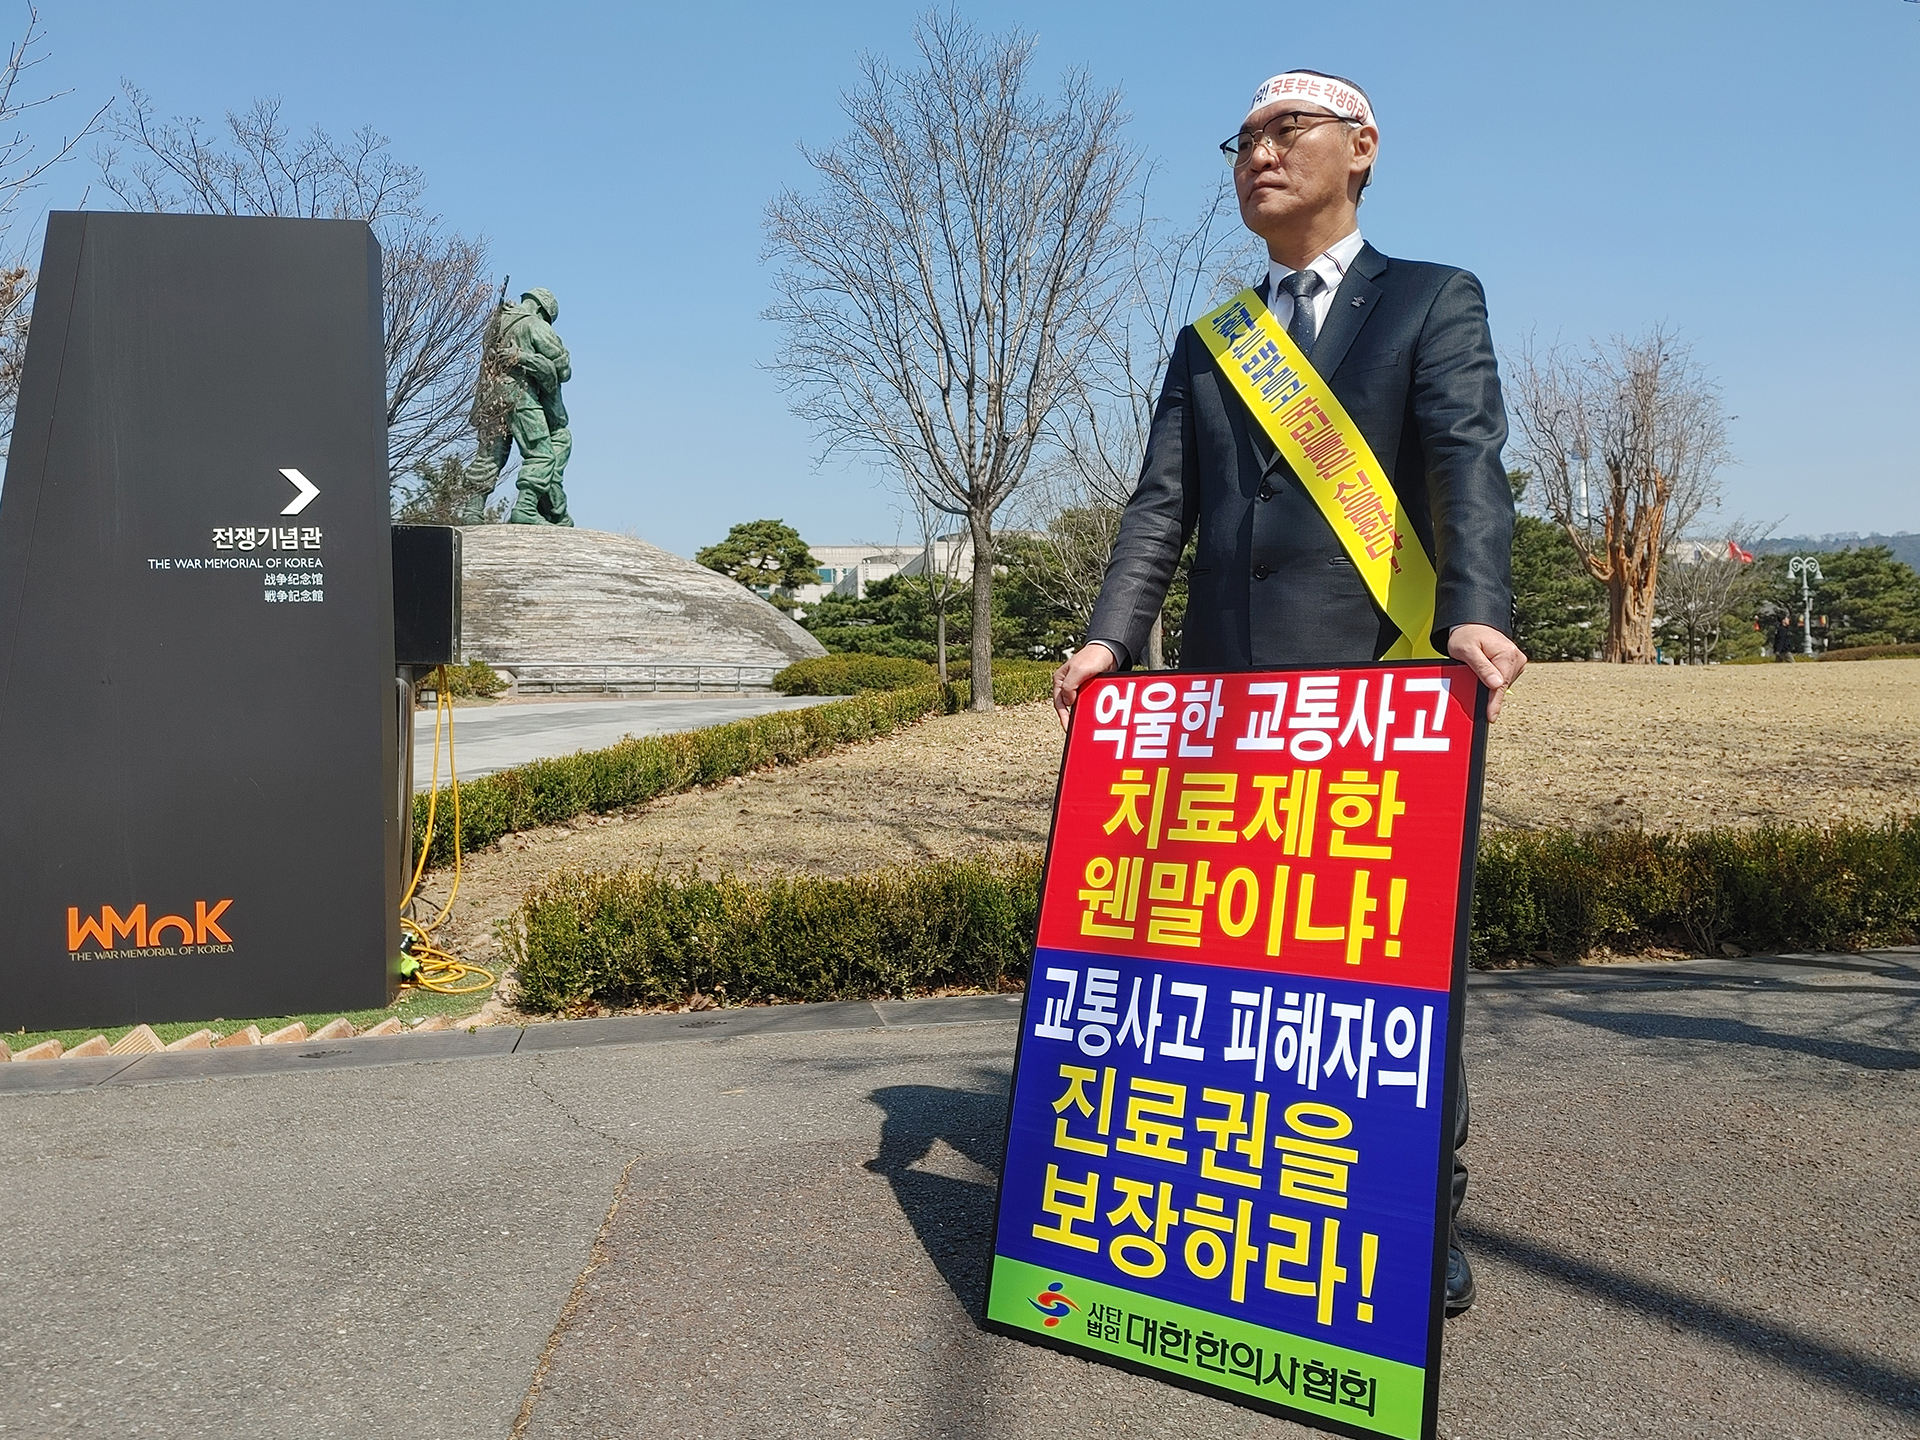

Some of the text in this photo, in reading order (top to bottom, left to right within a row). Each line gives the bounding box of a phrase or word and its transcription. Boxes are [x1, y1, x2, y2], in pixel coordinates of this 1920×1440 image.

[1271, 78, 1321, 97] 국토부는
[1212, 301, 1404, 574] 보험사는 배부르고 국민들은 신음한다!
[148, 557, 323, 569] THE WAR MEMORIAL OF KOREA
[212, 526, 323, 551] 전쟁기념관
[264, 572, 324, 585] 战争纪念馆
[1092, 672, 1452, 762] 억울한 교통사고
[1102, 767, 1406, 860] 치료제한
[69, 944, 235, 961] THE WAR MEMORIAL OF KOREA
[1078, 856, 1408, 966] 웬말이냐!
[1034, 965, 1434, 1108] 교통사고 피해자의
[1051, 1063, 1359, 1210] 진료권을
[1031, 1163, 1379, 1327] 보장하라!
[1086, 1318, 1121, 1344] 법인
[1087, 1302, 1123, 1326] 사단
[1125, 1313, 1377, 1417] 대한한의사협회
